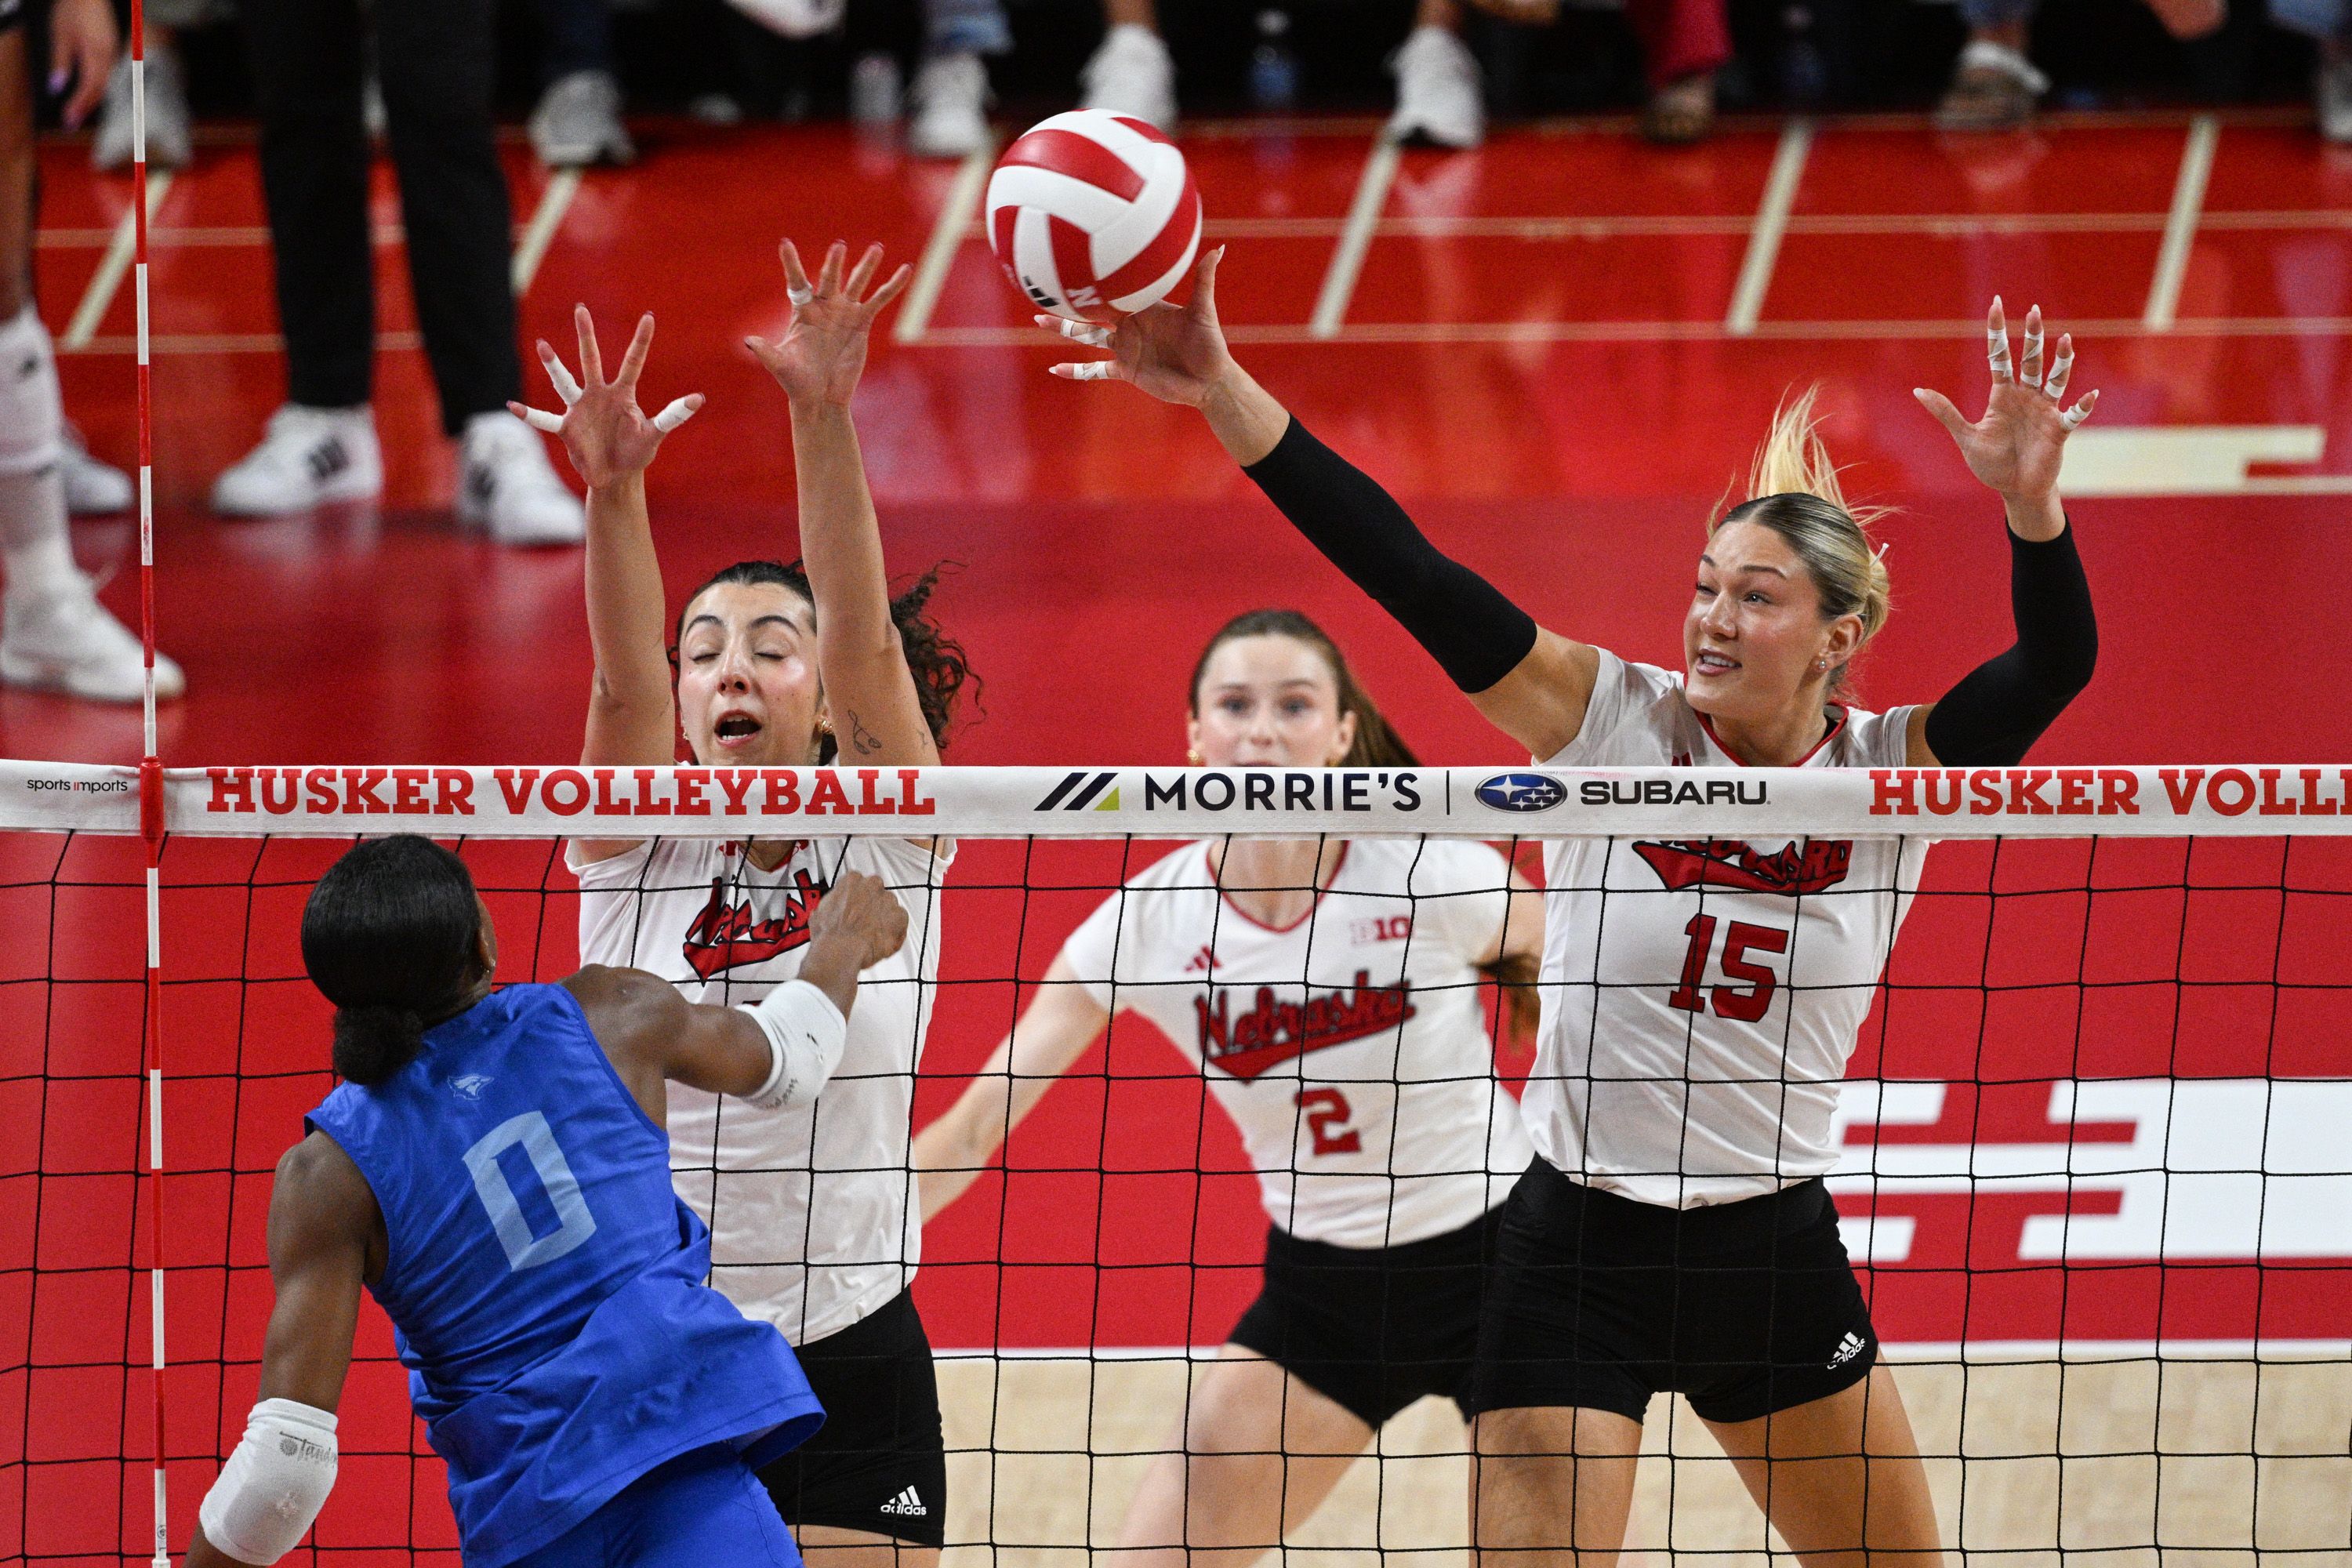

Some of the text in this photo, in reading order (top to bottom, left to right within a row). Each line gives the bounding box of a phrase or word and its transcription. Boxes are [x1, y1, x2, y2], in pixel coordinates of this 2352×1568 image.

[27, 779, 128, 793] sports imports
[206, 767, 935, 816] HUSKER VOLLEYBALL
[1145, 772, 1421, 811] MORRIE'S
[1580, 780, 1772, 805] SUBARU
[1868, 768, 2140, 815] HUSKER
[1668, 912, 1789, 1022] 15
[1193, 969, 1416, 1062] Nebraska
[1294, 1087, 1361, 1156] 2
[462, 1110, 597, 1272] 0
[1827, 1338, 1865, 1370] adidas
[880, 1502, 927, 1515] adidas
